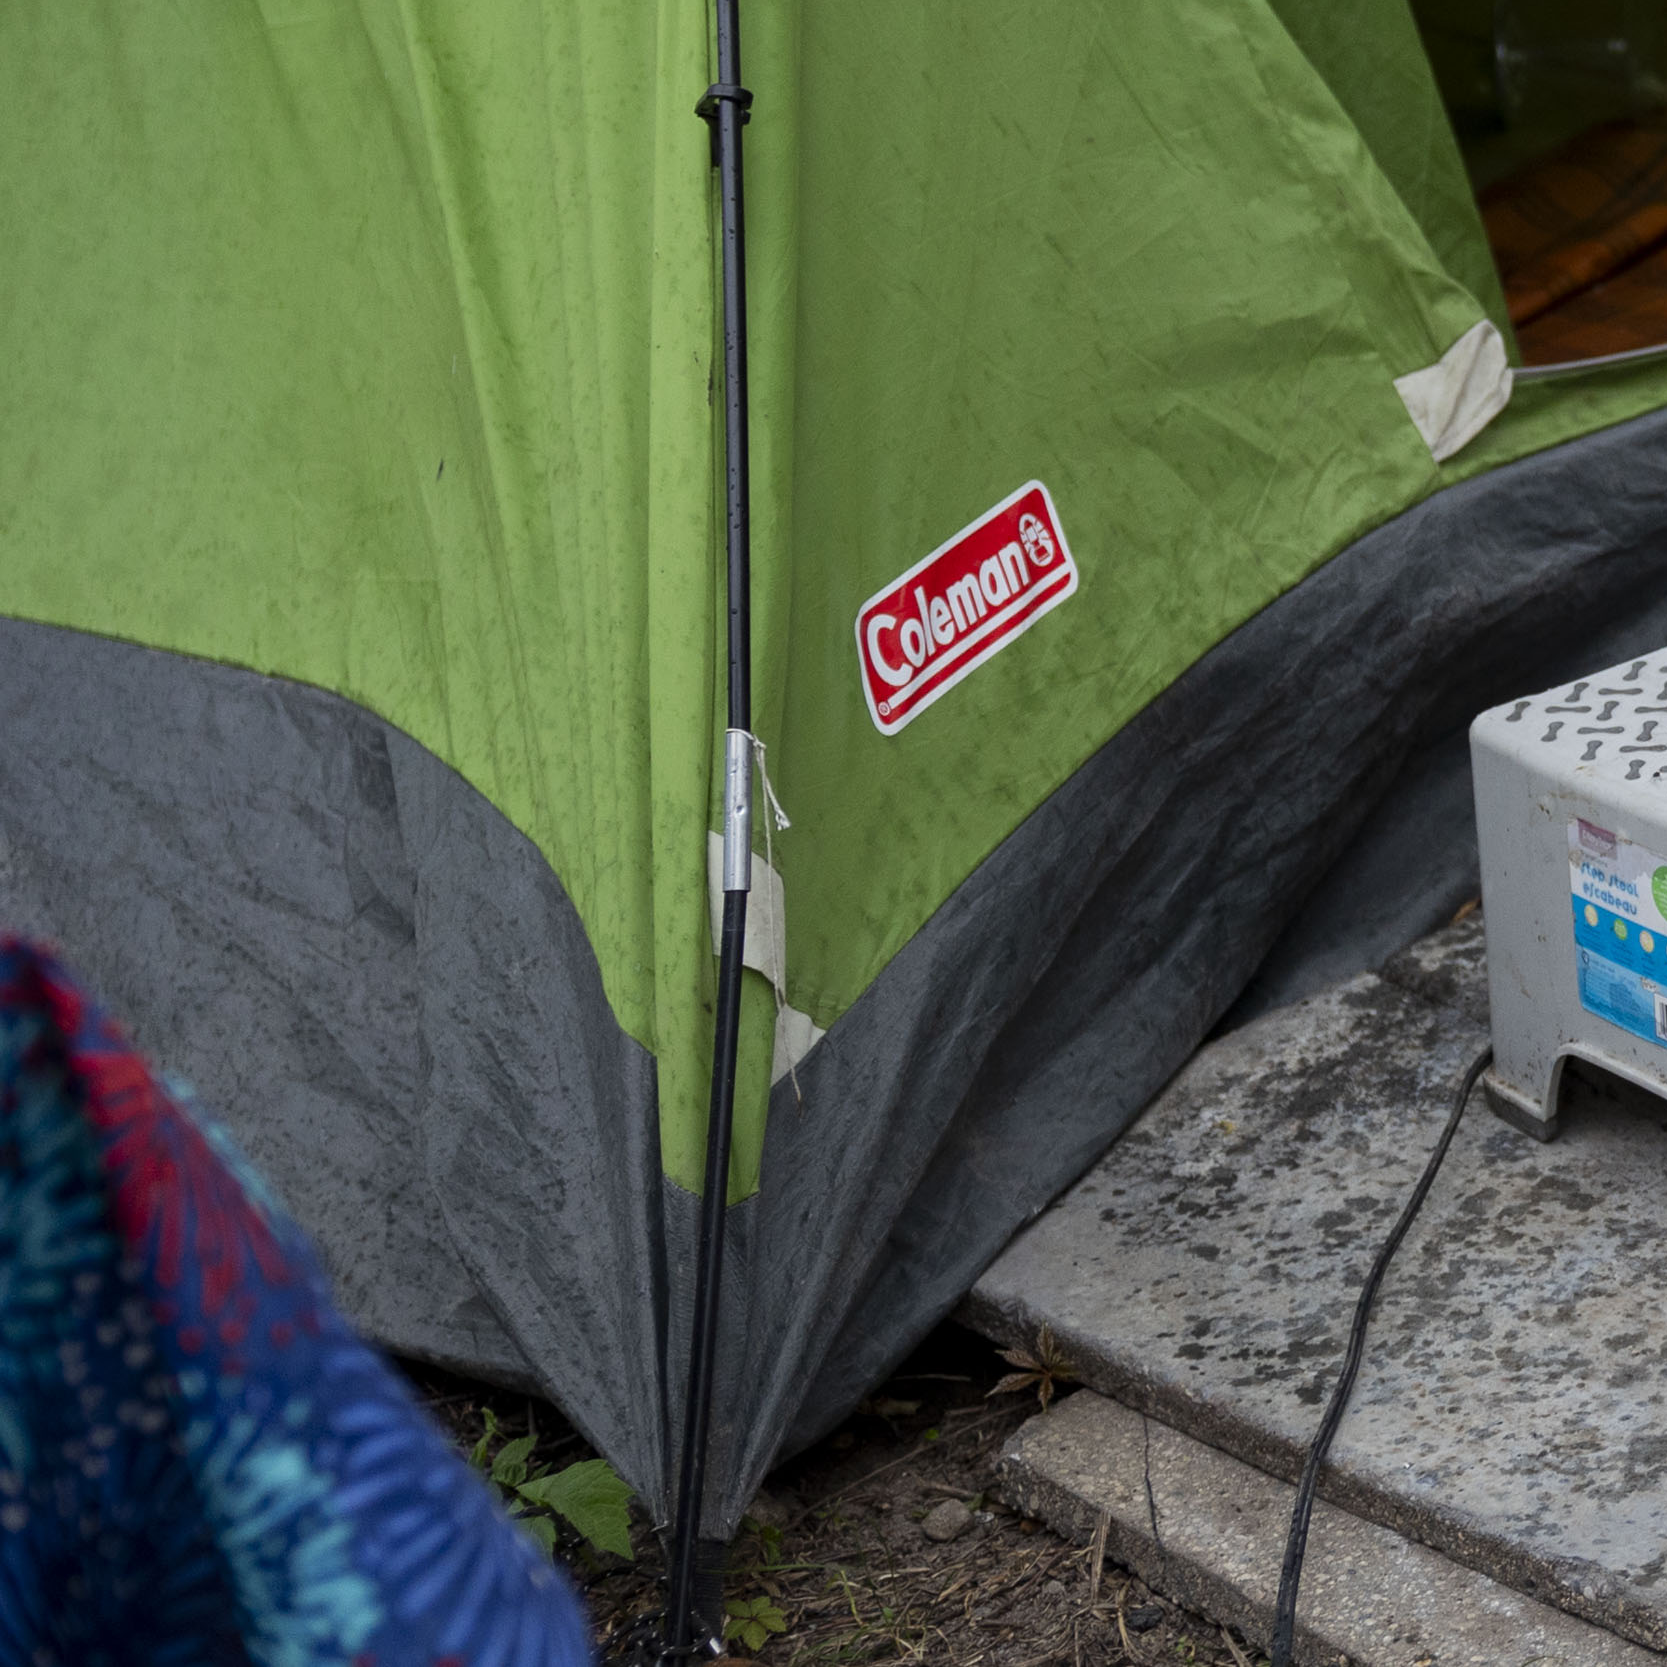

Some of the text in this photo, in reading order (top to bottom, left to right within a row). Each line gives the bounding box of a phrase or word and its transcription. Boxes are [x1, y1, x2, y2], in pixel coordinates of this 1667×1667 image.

[866, 540, 1030, 687] Coleman
[1581, 861, 1606, 883] step
[1582, 881, 1638, 916] escabeau
